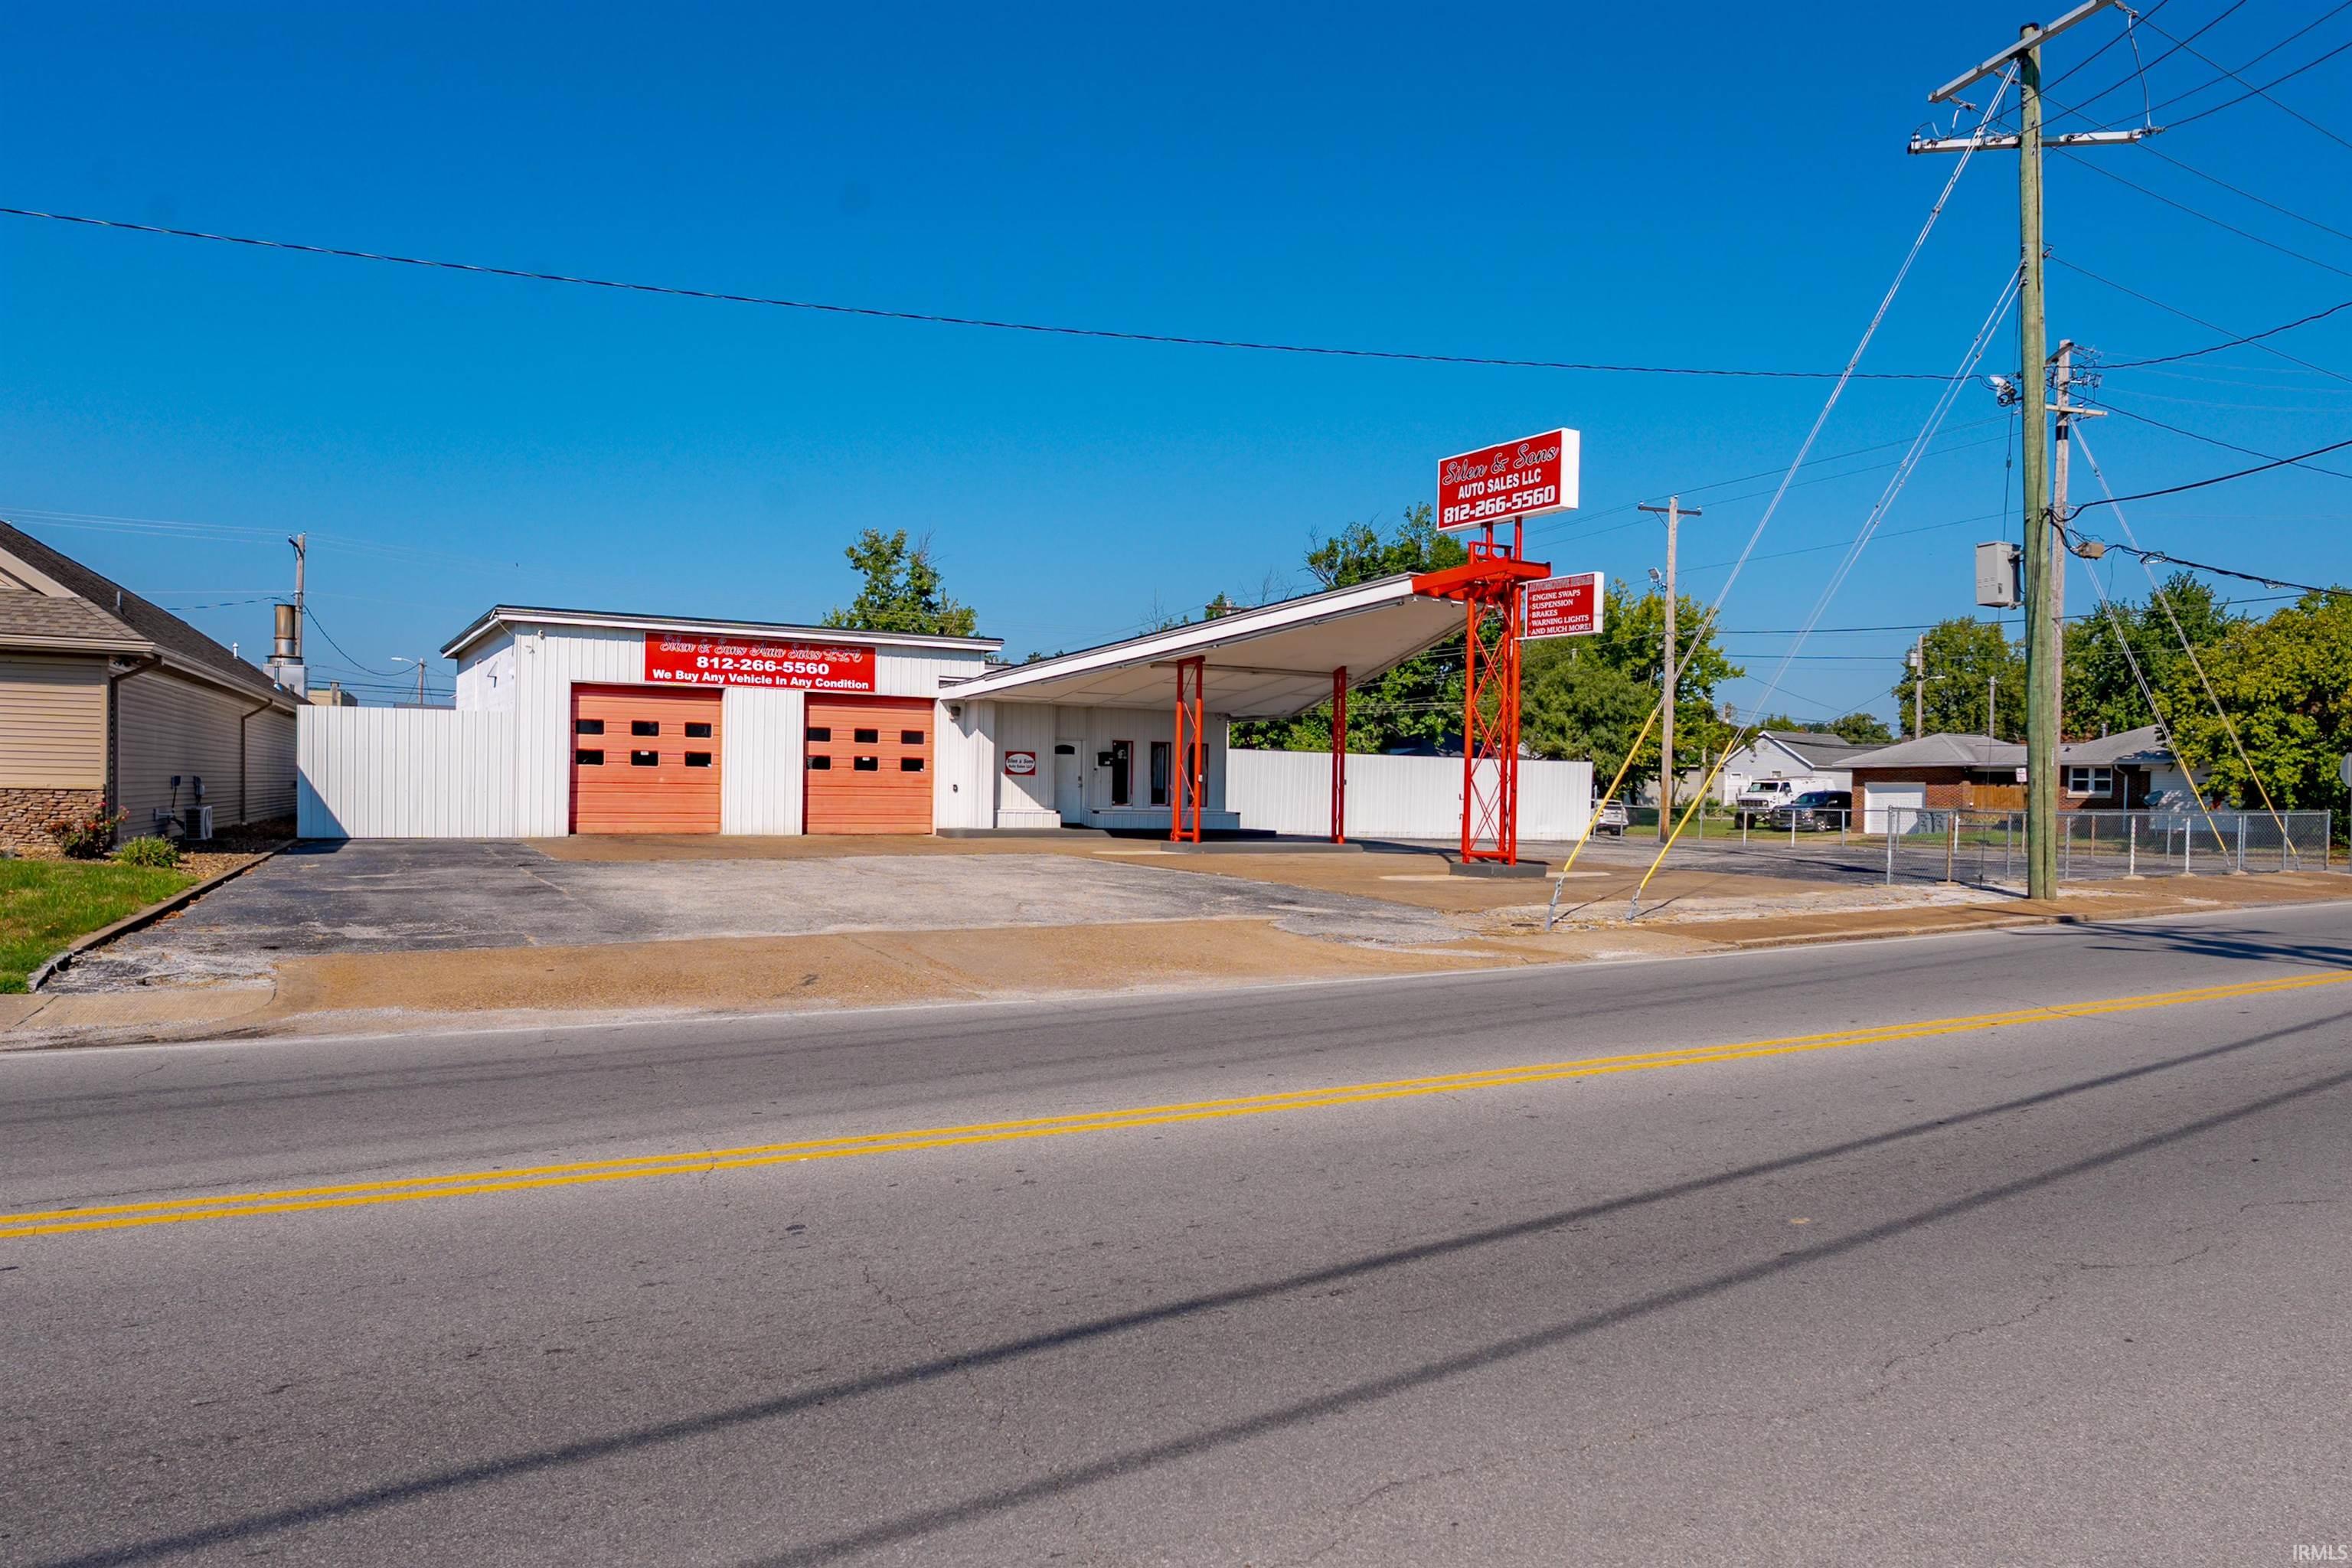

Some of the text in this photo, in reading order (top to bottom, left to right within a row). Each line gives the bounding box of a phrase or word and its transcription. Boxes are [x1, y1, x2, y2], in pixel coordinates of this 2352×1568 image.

[1442, 443, 1560, 485] Silen & Sons
[1458, 468, 1541, 500] AUTO SALES LLC
[1443, 485, 1556, 524] 812-266-5560
[1531, 599, 1573, 610] SUSPENSION
[1532, 590, 1581, 601] ENGINE SWAPS
[1531, 609, 1558, 619] BRAKES
[1531, 614, 1589, 626] WARNING LIGHTS
[1547, 626, 1567, 634] MUCH
[1568, 622, 1592, 632] MORE!
[659, 635, 696, 652] Silen
[697, 638, 713, 654] &
[714, 637, 748, 655] Sons
[750, 640, 787, 658] Auto
[787, 644, 823, 660] Sales
[696, 656, 830, 675] 812-266-5560
[652, 669, 869, 690] We Buy Any Vehicle In Any Condition
